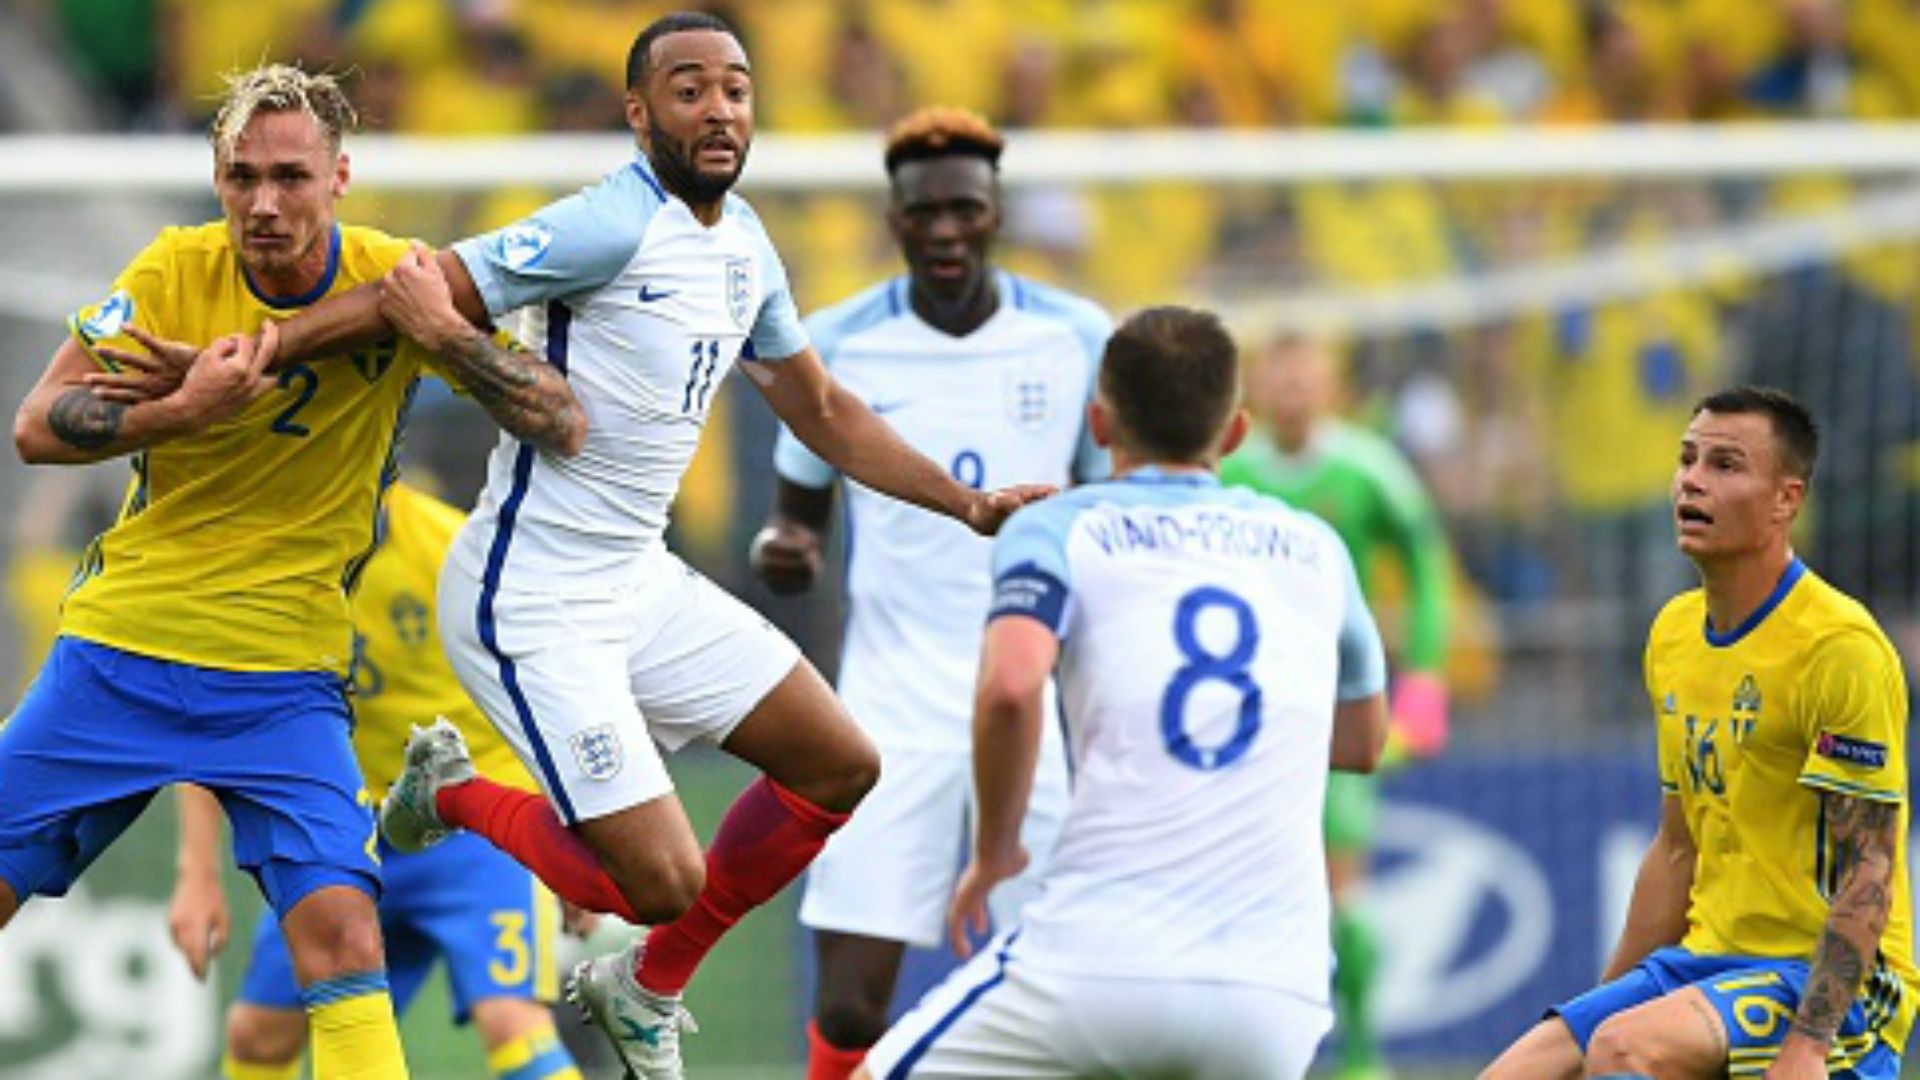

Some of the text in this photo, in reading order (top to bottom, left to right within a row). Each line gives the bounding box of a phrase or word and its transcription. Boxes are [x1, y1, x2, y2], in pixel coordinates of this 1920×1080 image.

[270, 363, 319, 437] 2
[681, 340, 719, 413] 11
[1159, 585, 1263, 772] 8
[1684, 714, 1726, 795] 16
[487, 909, 529, 987] 3
[1712, 971, 1795, 1039] 16
